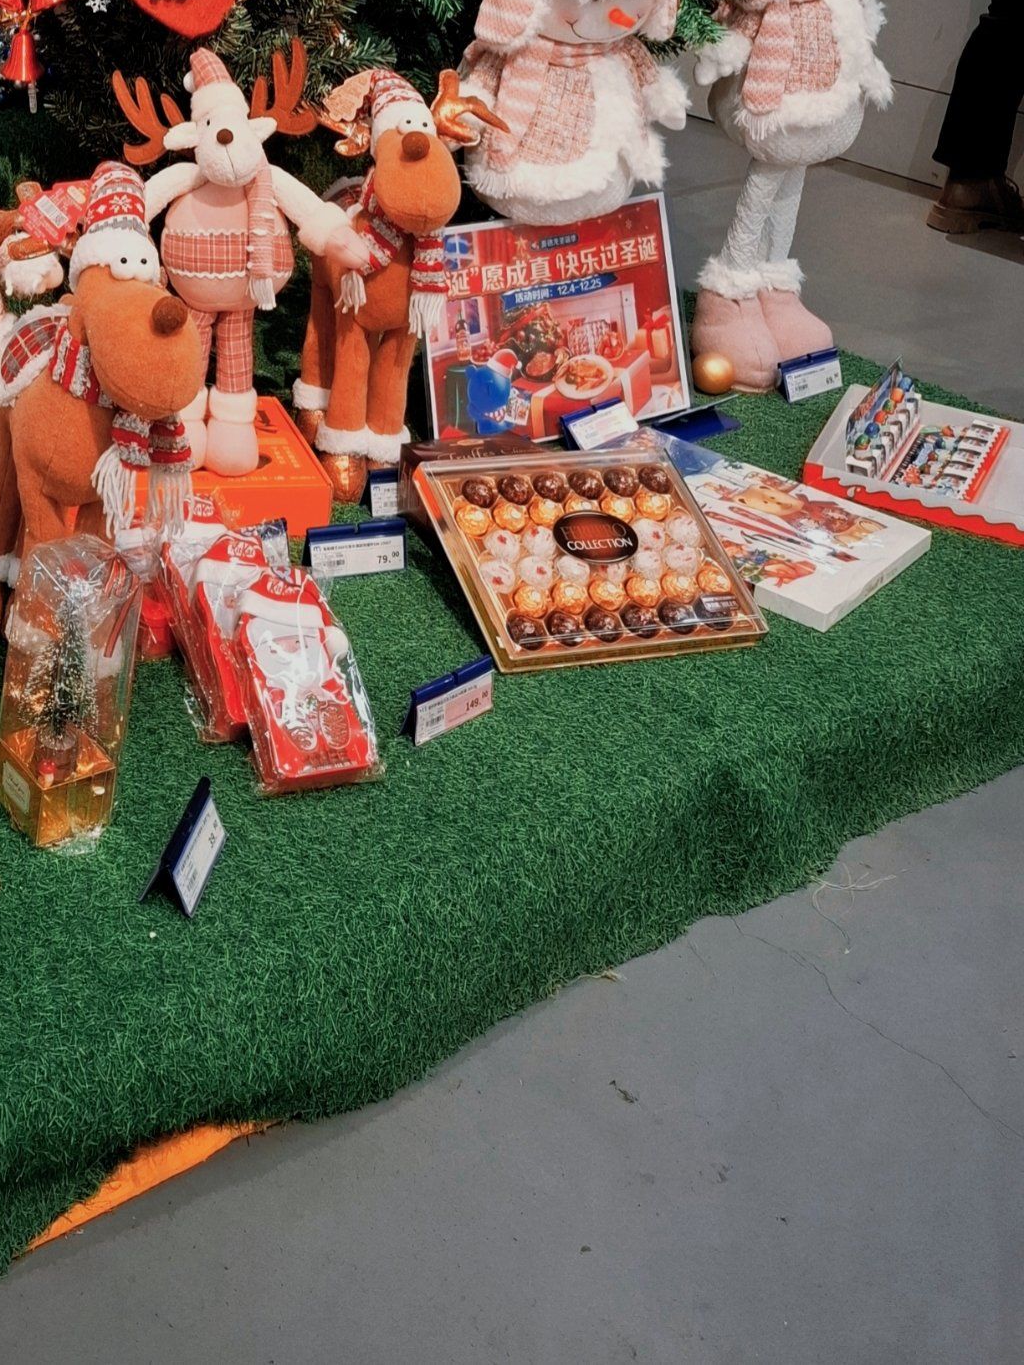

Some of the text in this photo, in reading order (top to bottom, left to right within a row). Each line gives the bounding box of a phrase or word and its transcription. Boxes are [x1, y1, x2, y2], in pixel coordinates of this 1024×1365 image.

[555, 235, 660, 279] 快乐过圣诞
[557, 277, 602, 296] 12.4-12.25
[567, 537, 634, 551] COLLECTION
